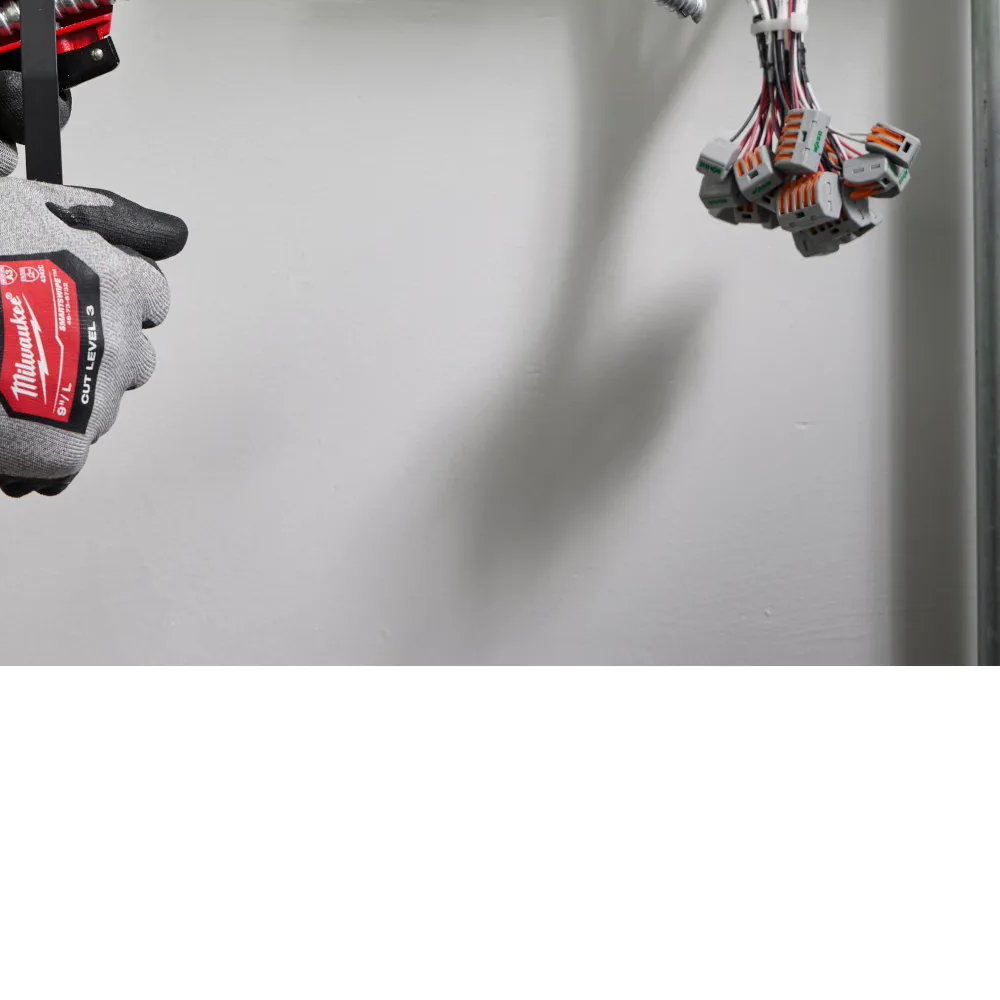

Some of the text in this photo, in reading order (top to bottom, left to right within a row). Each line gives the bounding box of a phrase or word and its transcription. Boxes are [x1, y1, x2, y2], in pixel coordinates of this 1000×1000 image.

[4, 269, 14, 280] A3
[81, 305, 97, 404] CUT LEVEL 3
